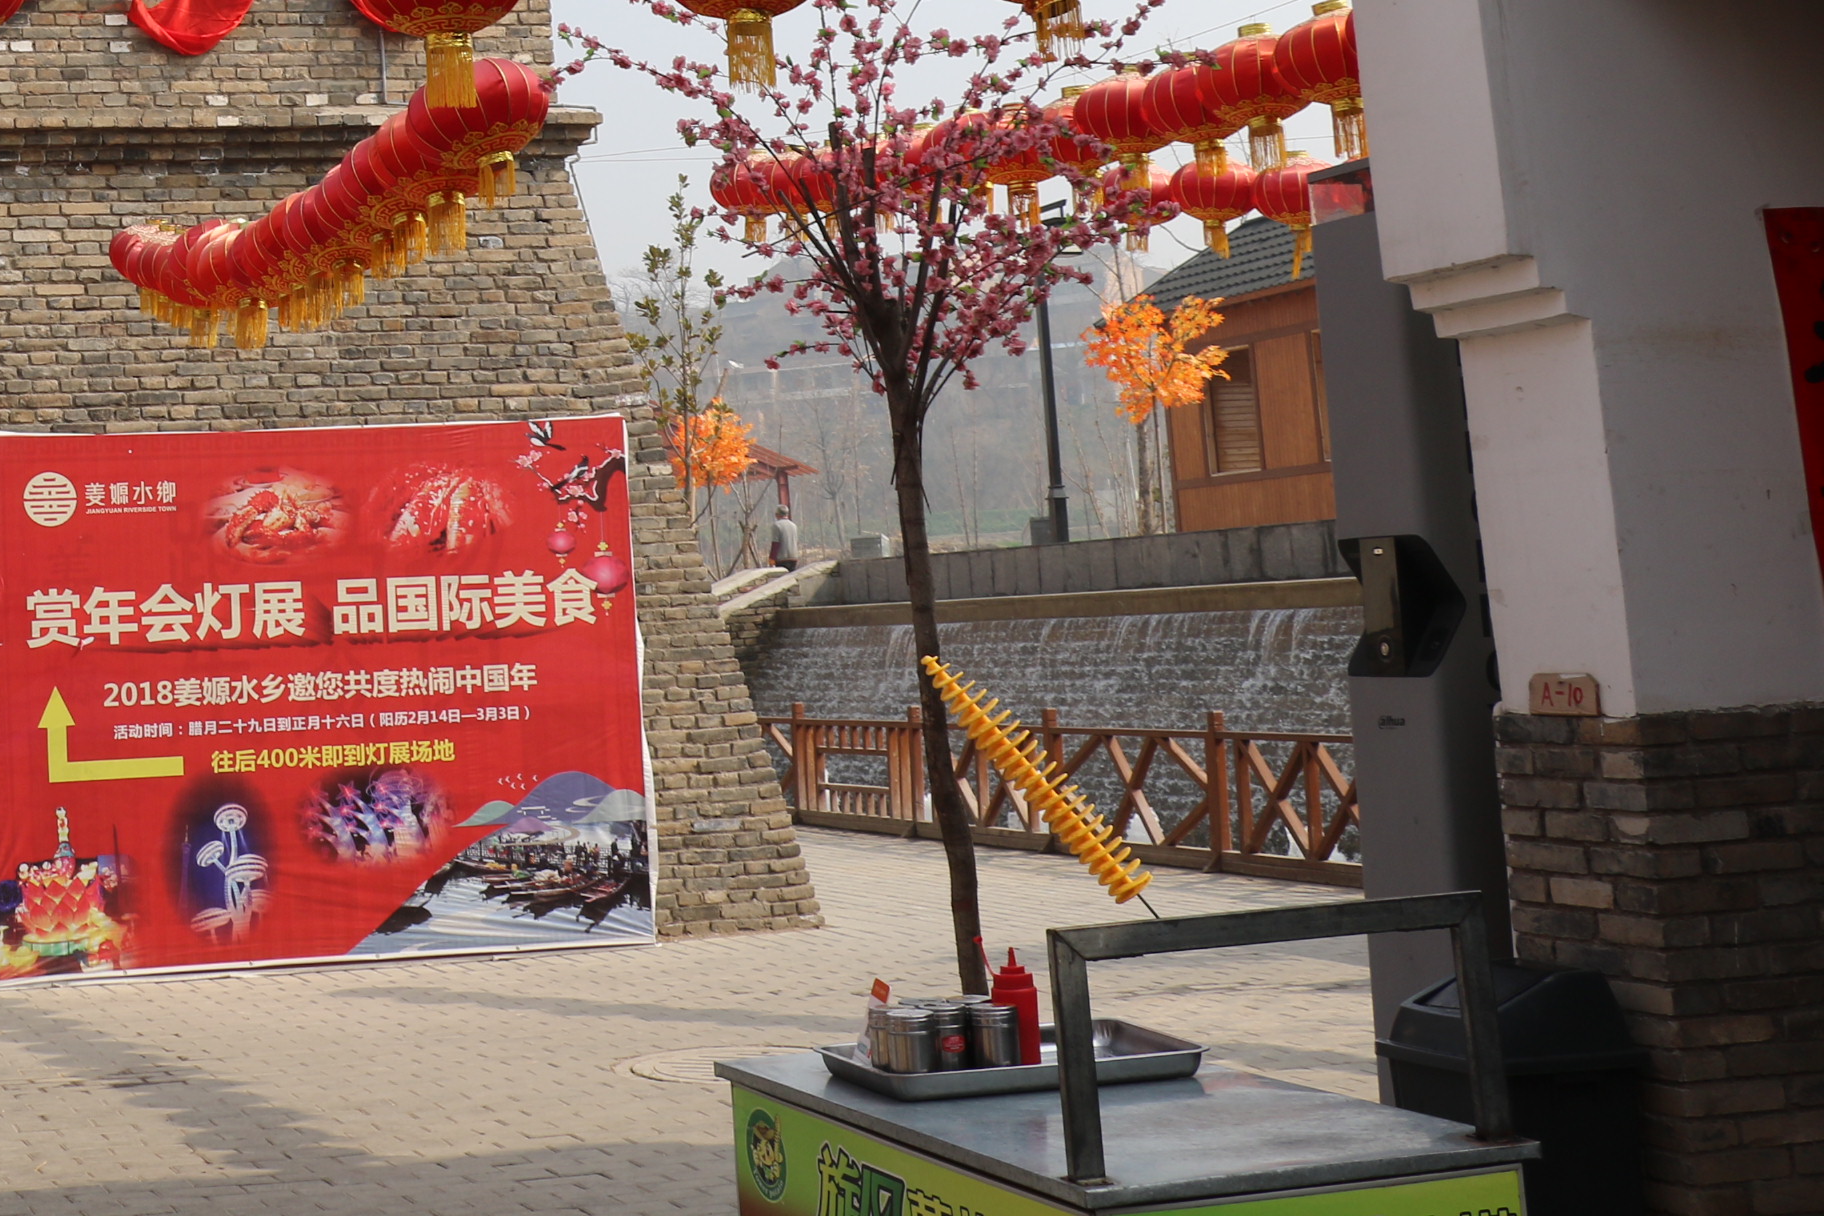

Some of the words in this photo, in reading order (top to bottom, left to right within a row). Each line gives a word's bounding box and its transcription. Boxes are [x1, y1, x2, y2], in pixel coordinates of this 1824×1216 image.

[26, 581, 306, 649] 赏年会灯展
[332, 568, 598, 635] 品国际美食
[103, 663, 538, 708] 2018姜嫄水乡邀您共度热闹中国年
[1541, 682, 1583, 706] A-10
[211, 738, 456, 774] 往后400米即到灯展场地
